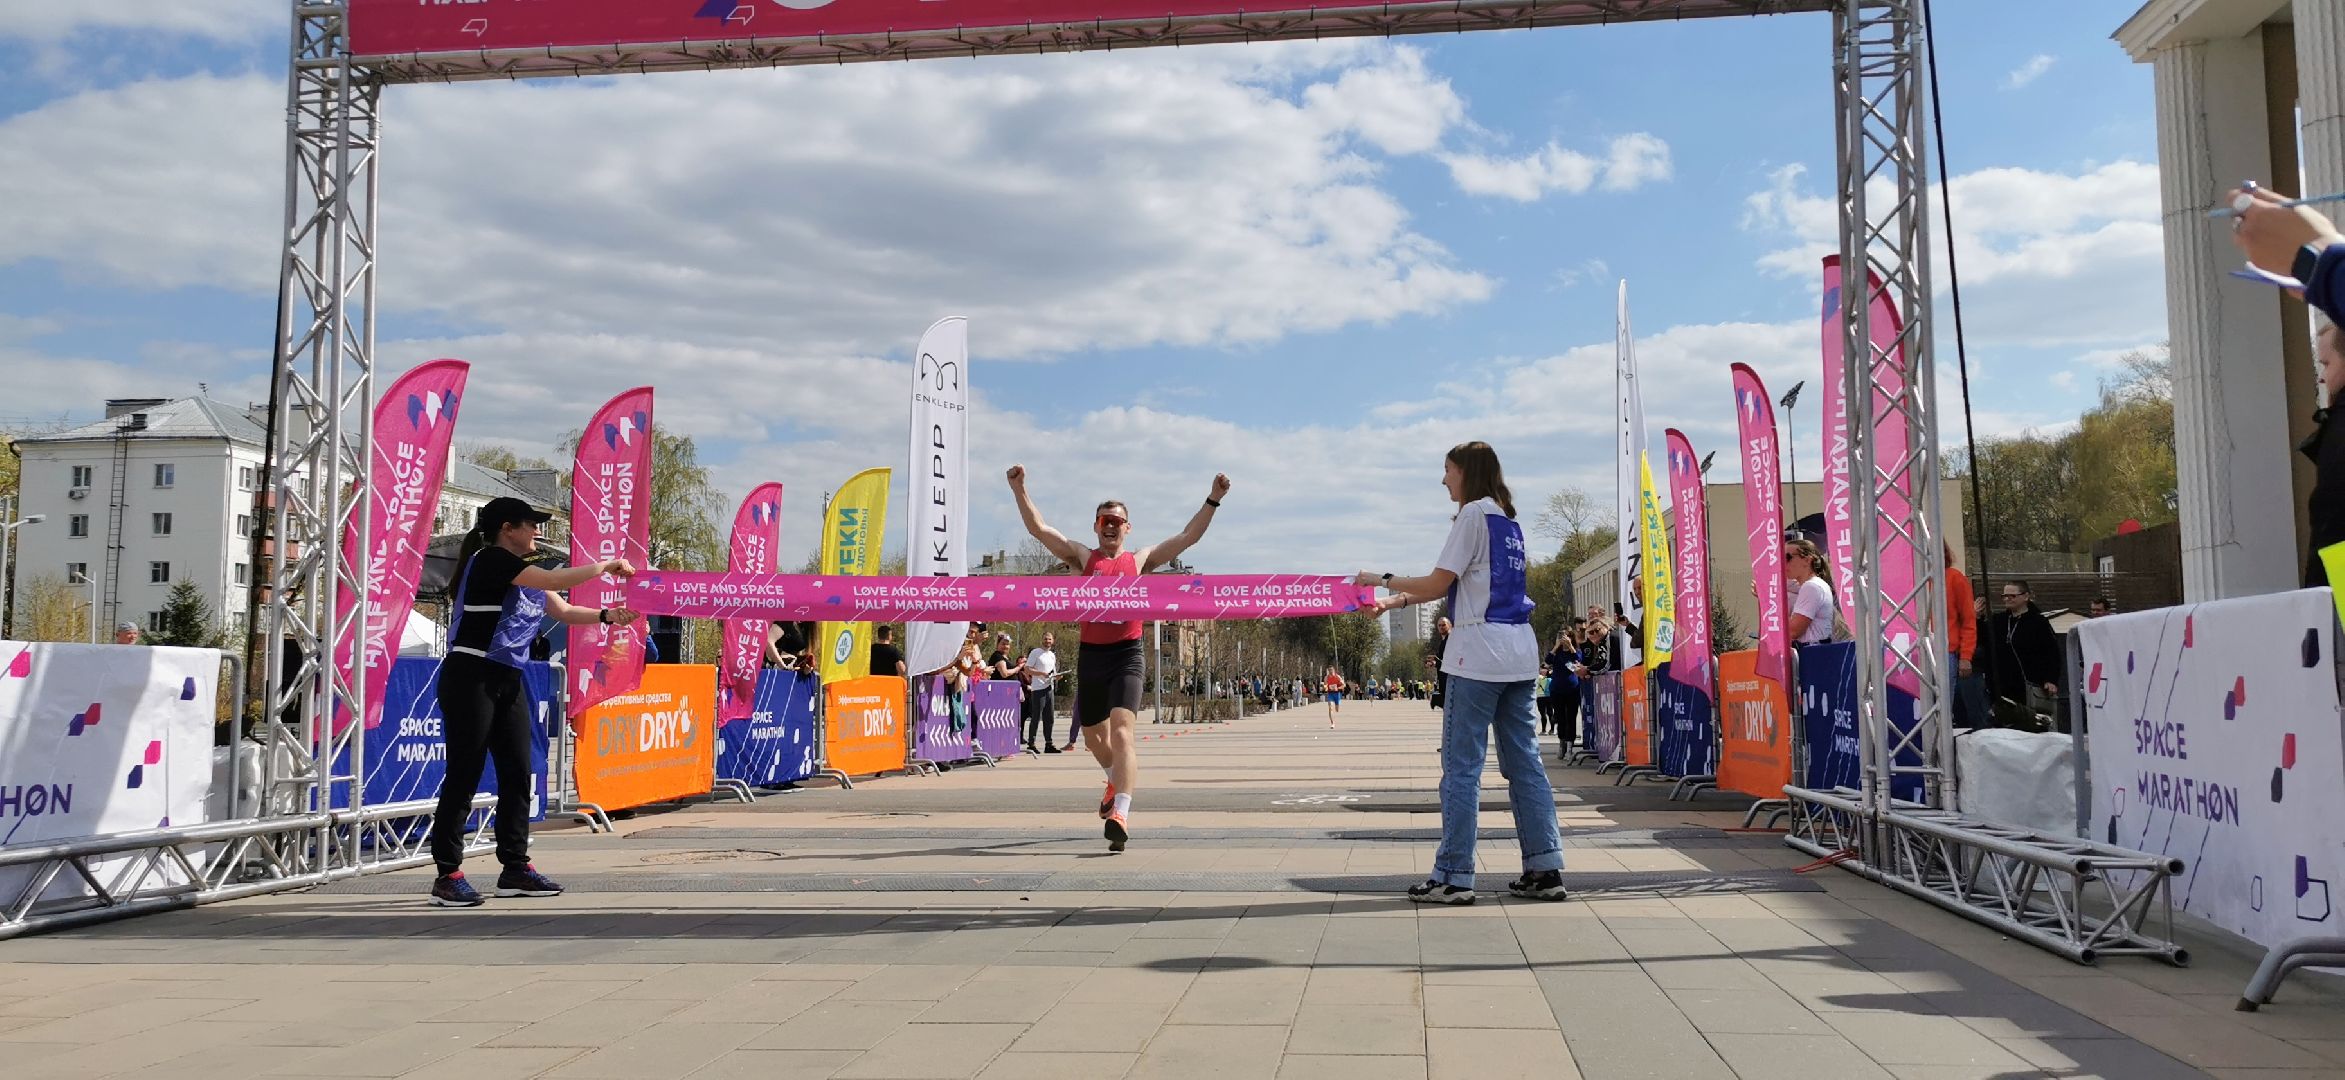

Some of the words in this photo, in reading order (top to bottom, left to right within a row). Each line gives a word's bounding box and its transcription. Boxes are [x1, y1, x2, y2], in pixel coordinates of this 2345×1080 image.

[915, 393, 965, 413] ENKLEPP
[598, 463, 615, 534] SPACE
[933, 424, 949, 624] KLEPP
[710, 583, 738, 595] AND
[741, 583, 785, 596] SPACE
[892, 585, 919, 597] AND
[922, 585, 967, 597] SPACE
[1071, 587, 1100, 598] AND
[1103, 587, 1148, 598] SPACE
[1251, 585, 1281, 596] AND
[1285, 584, 1331, 596] SPACE
[674, 595, 708, 607] HALF
[855, 599, 890, 610] HALF
[1036, 599, 1070, 610] HALF
[1214, 599, 1250, 608] HALF
[743, 635, 761, 681] HALF
[752, 712, 772, 723] SPACE
[400, 718, 441, 736] SPACE
[2134, 719, 2187, 760] SPACE
